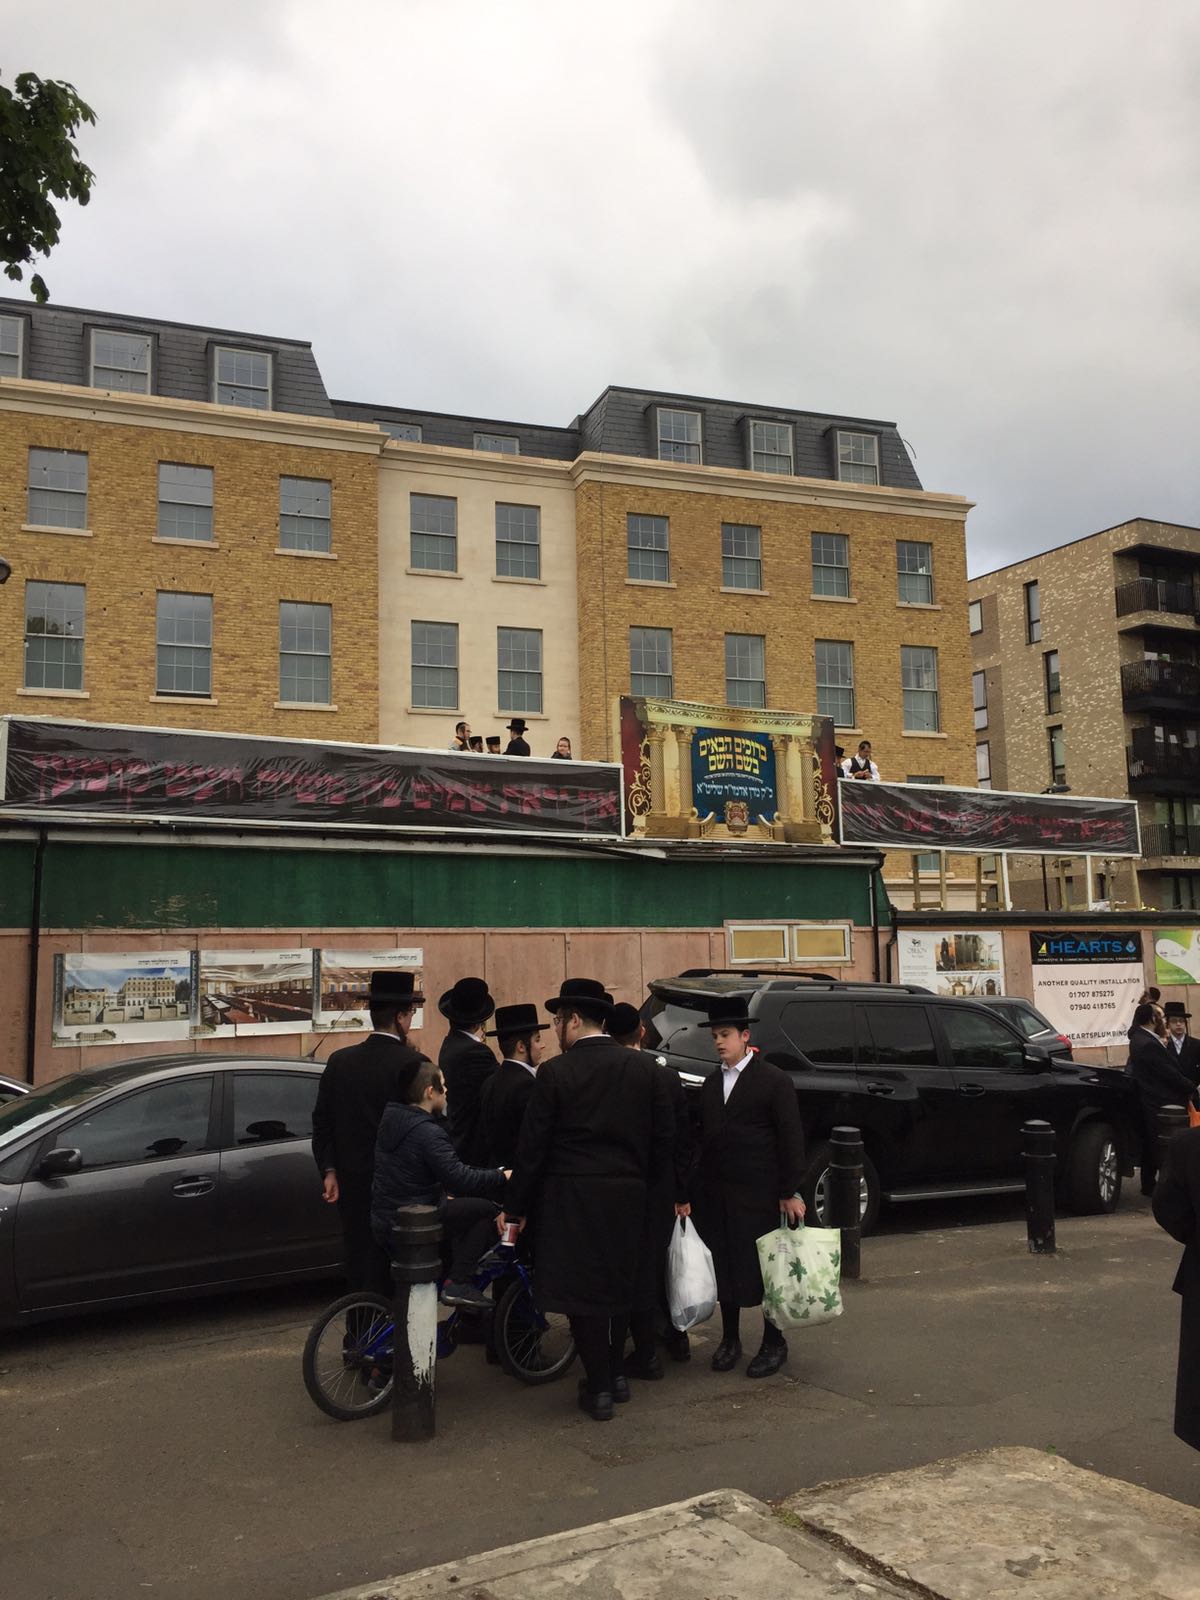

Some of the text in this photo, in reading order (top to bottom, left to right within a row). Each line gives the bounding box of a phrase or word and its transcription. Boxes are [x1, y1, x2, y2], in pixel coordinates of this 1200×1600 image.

[699, 736, 768, 762] ברוכים הבאים
[708, 753, 760, 775] בשם השם
[1050, 940, 1123, 954] HEARTS
[1038, 979, 1069, 987] ANOTHER
[1069, 1003, 1091, 1011] 07940
